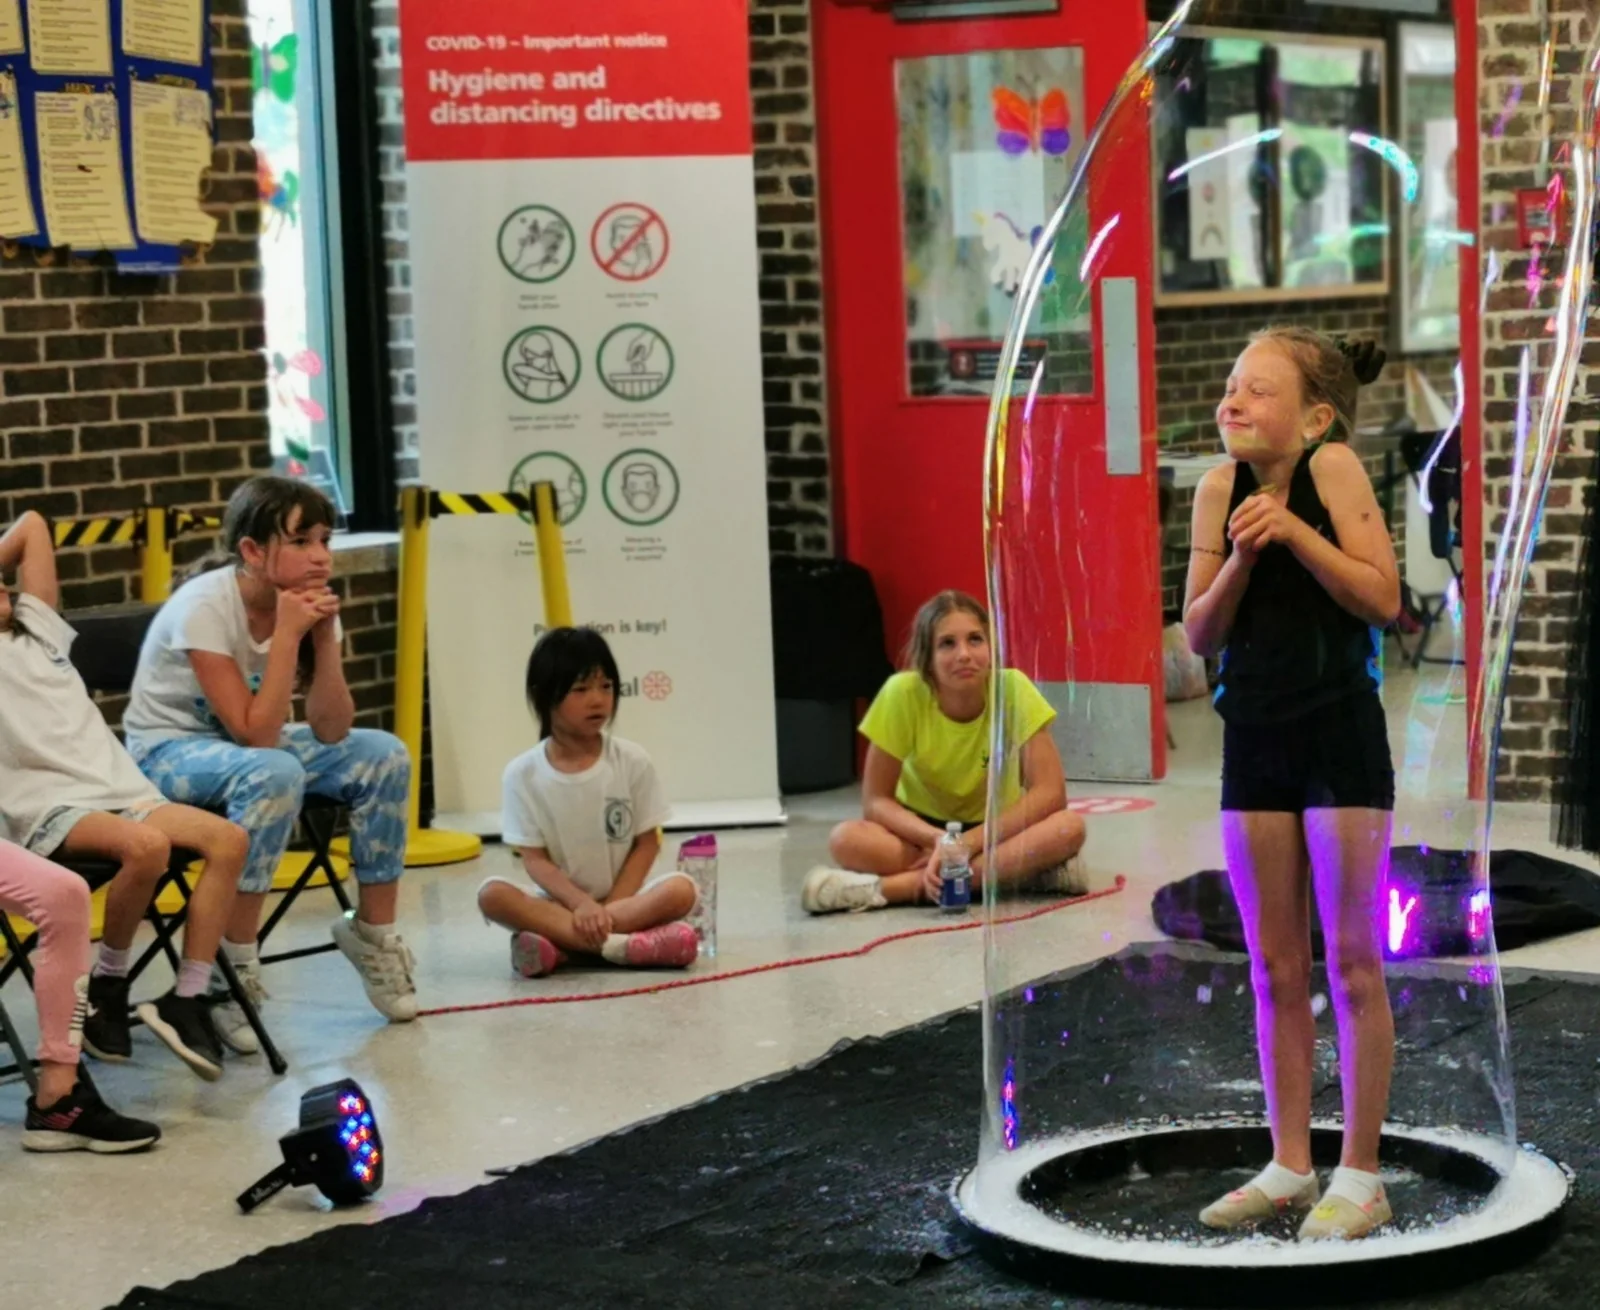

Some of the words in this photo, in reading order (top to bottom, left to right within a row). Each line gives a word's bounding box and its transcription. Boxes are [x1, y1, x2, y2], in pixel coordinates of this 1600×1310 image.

[426, 35, 507, 51] COVID-19
[523, 34, 609, 52] Important
[614, 33, 667, 48] notice
[428, 67, 544, 97] Hygiene
[552, 65, 606, 90] and
[430, 99, 577, 128] distancing
[584, 97, 721, 122] directives
[619, 619, 632, 633] is
[636, 618, 667, 636] key!
